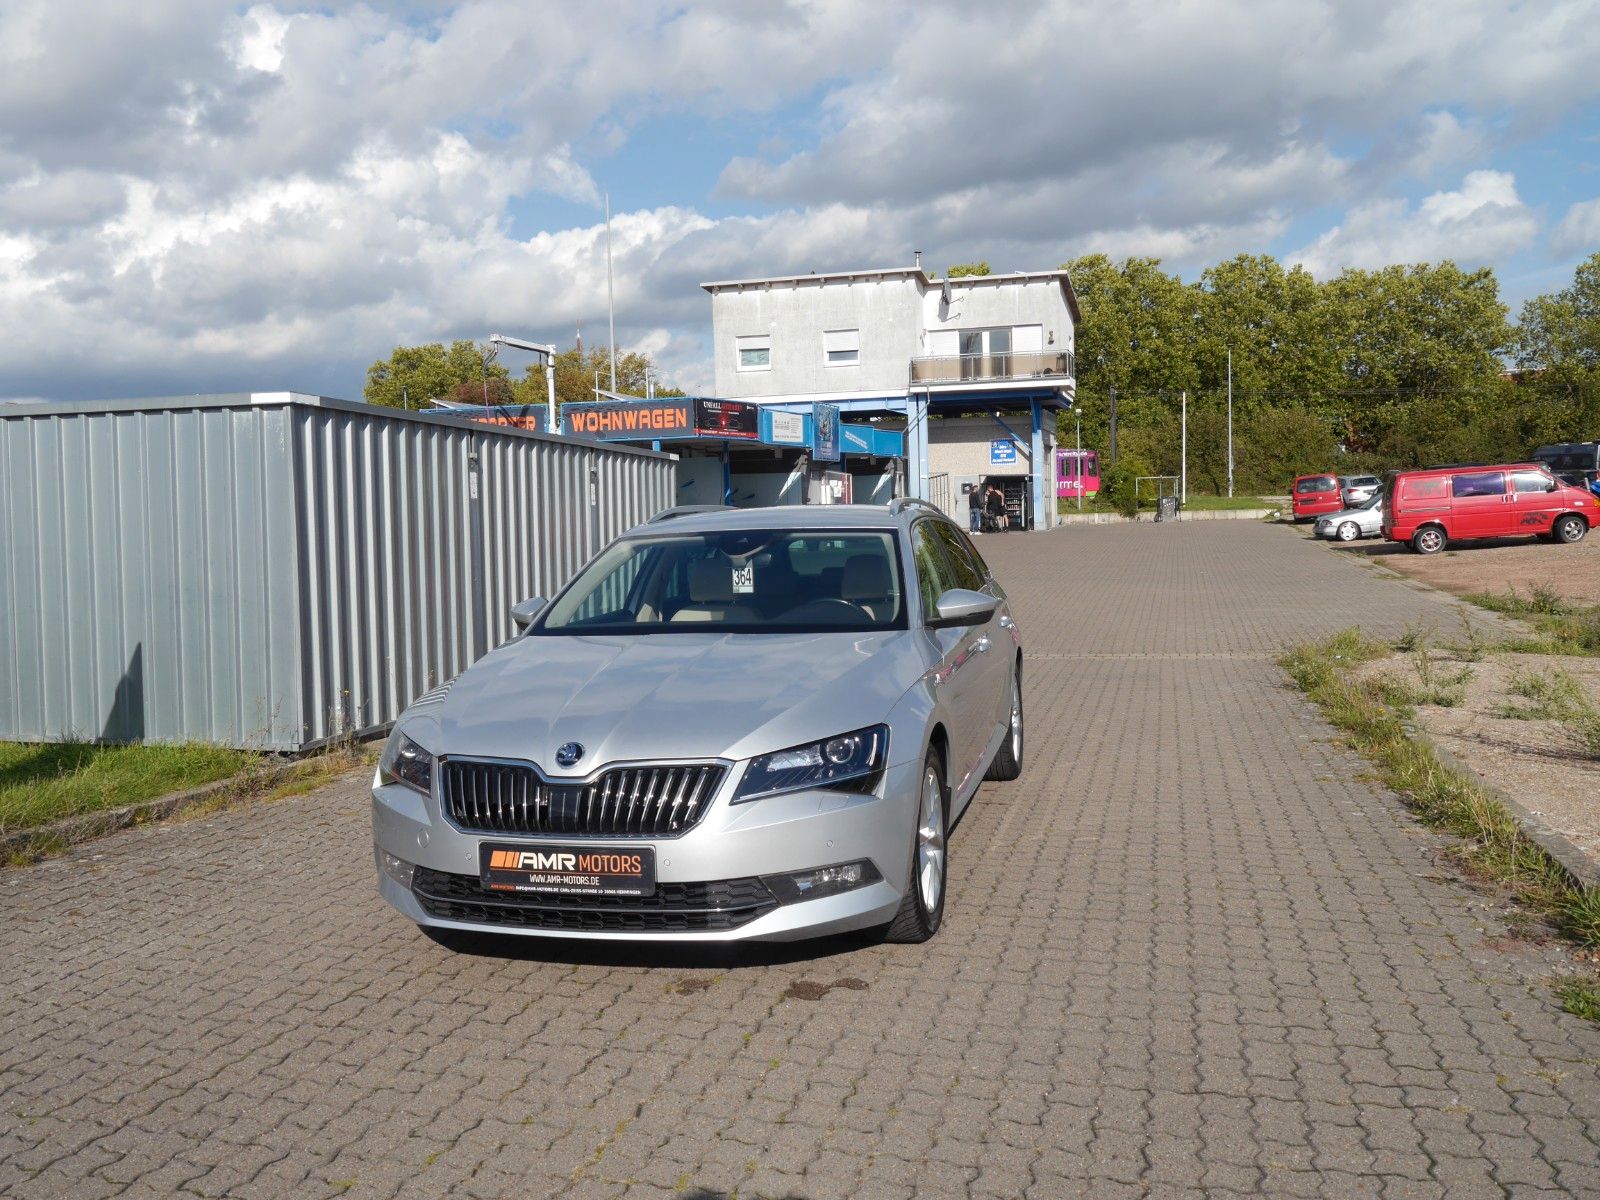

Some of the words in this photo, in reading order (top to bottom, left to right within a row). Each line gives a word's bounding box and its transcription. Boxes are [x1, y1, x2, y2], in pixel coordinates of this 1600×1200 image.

[571, 408, 687, 432] WOHNWAGEN
[734, 568, 752, 585] 364
[518, 852, 577, 871] AMR
[579, 854, 641, 873] MOTORS
[530, 874, 600, 886] WWW.AMR-MOTORS.DE
